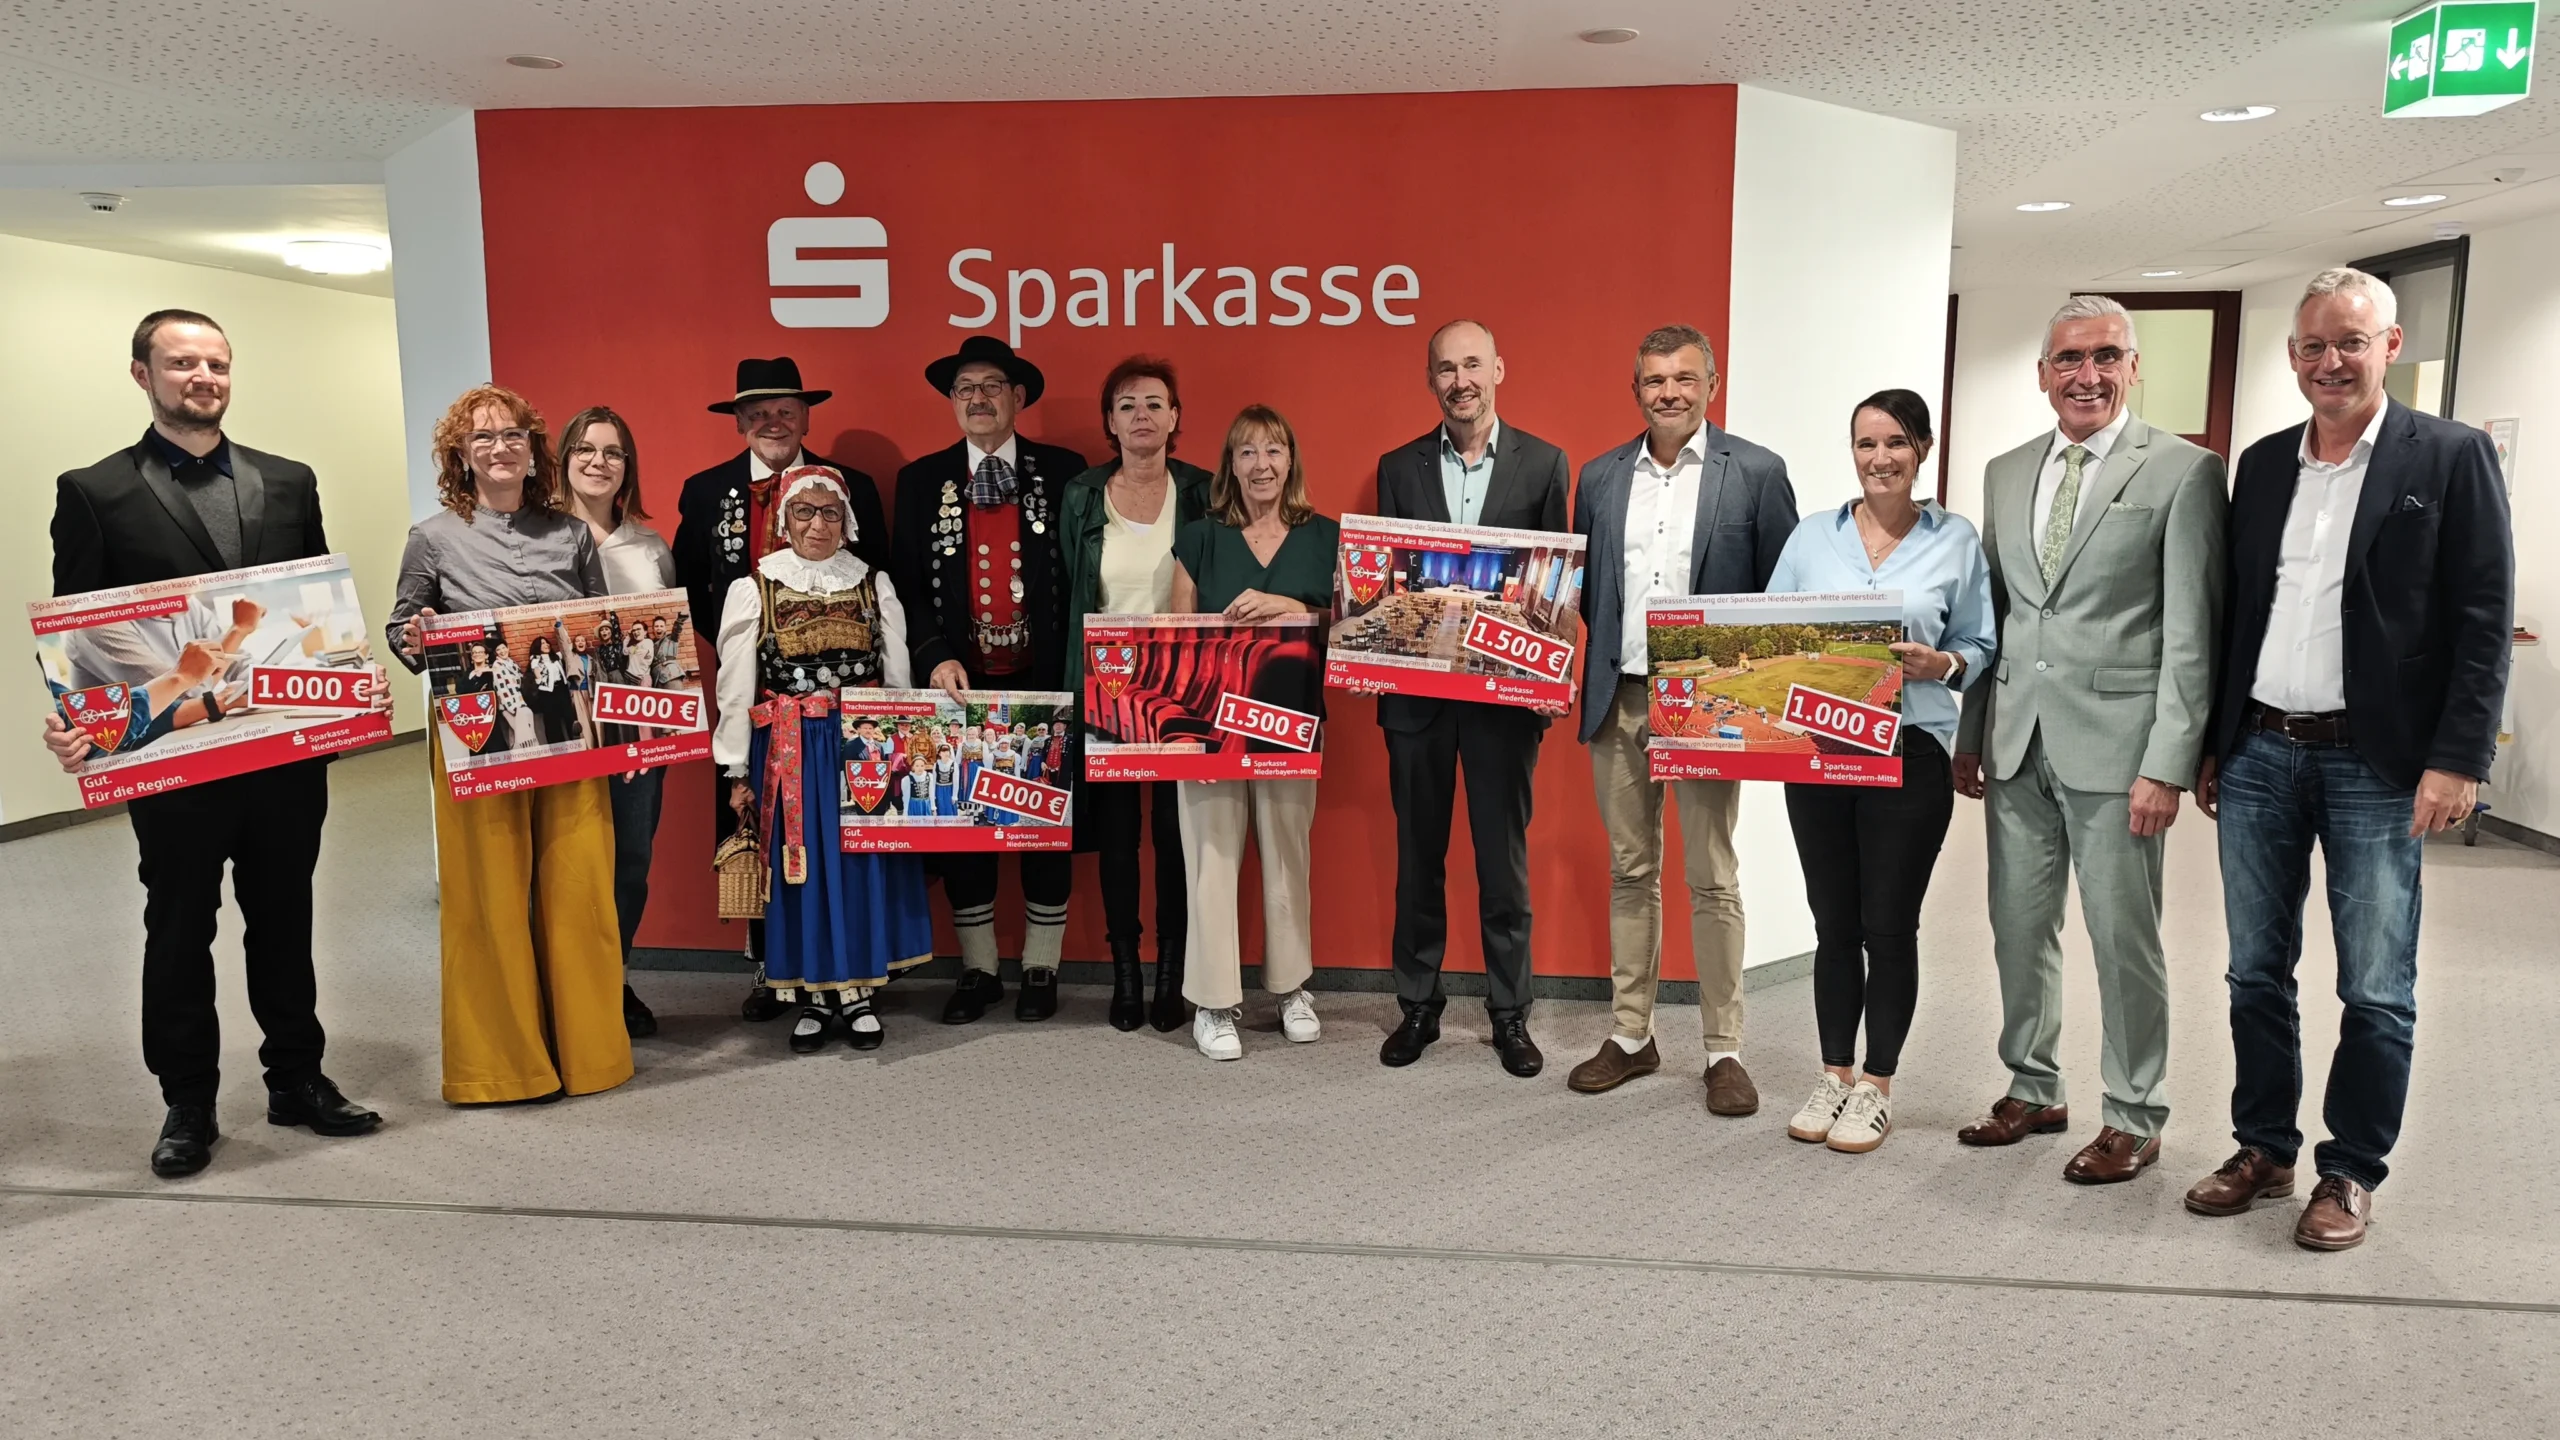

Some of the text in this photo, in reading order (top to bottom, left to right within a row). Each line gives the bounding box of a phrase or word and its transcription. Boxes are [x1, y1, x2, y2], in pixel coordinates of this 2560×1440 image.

[947, 242, 1419, 348] Sparkasse
[1345, 517, 1383, 526] Sparkassen
[1427, 524, 1463, 533] Sparkasse
[1418, 539, 1463, 549] Burgtheaters
[32, 596, 90, 611] Sparkassen
[91, 589, 130, 601] Stiftung
[133, 587, 148, 595] der
[150, 581, 197, 593] Sparkasse
[199, 565, 284, 584] Niederbayern-Mitte
[1650, 597, 1687, 606] Sparkassen
[1689, 596, 1715, 605] Stiftung
[1730, 595, 1766, 604] Sparkasse
[1768, 594, 1840, 603] Niederbayern-Mitte
[37, 600, 183, 629] Freiwilligenzentrum Straubing
[1667, 613, 1699, 621] Straubing
[426, 629, 479, 641] FEM-Connect
[1473, 622, 1566, 672] 1.500 €
[1330, 662, 1348, 672] Gut.
[258, 674, 370, 701] 1.000 €
[1329, 675, 1398, 690] Für die Region.
[1499, 685, 1534, 694] Sparkasse
[1498, 694, 1564, 706] Niederbayern-Mitte
[601, 692, 696, 721] 1.000 €
[845, 703, 893, 711] Trachtenverein
[1224, 703, 1312, 742] 1.500 €
[1791, 695, 1892, 744] 1.000 €
[309, 728, 350, 743] Sparkasse
[311, 729, 388, 752] Niederbayern-Mitte
[144, 750, 158, 759] des
[161, 744, 194, 755] Projekts
[565, 743, 582, 751] 2026
[641, 744, 676, 756] Sparkasse
[642, 747, 708, 763] Niederbayern-Mitte
[1089, 757, 1108, 765] Gut.
[1653, 750, 1671, 760] Gut.
[1254, 760, 1287, 768] Sparkasse
[1824, 762, 1862, 771] Sparkasse
[1089, 769, 1158, 778] Für die Region.
[1653, 764, 1721, 777] Für die Region.
[84, 775, 112, 788] Gut.
[452, 772, 475, 782] Gut.
[1824, 772, 1898, 783] Niederbayern-Mitte
[88, 774, 187, 803] Für die Region.
[455, 776, 536, 796] Für die Region.
[978, 777, 1065, 816] 1.000 €
[844, 828, 863, 836] Gut.
[844, 840, 912, 850] Für die Region.
